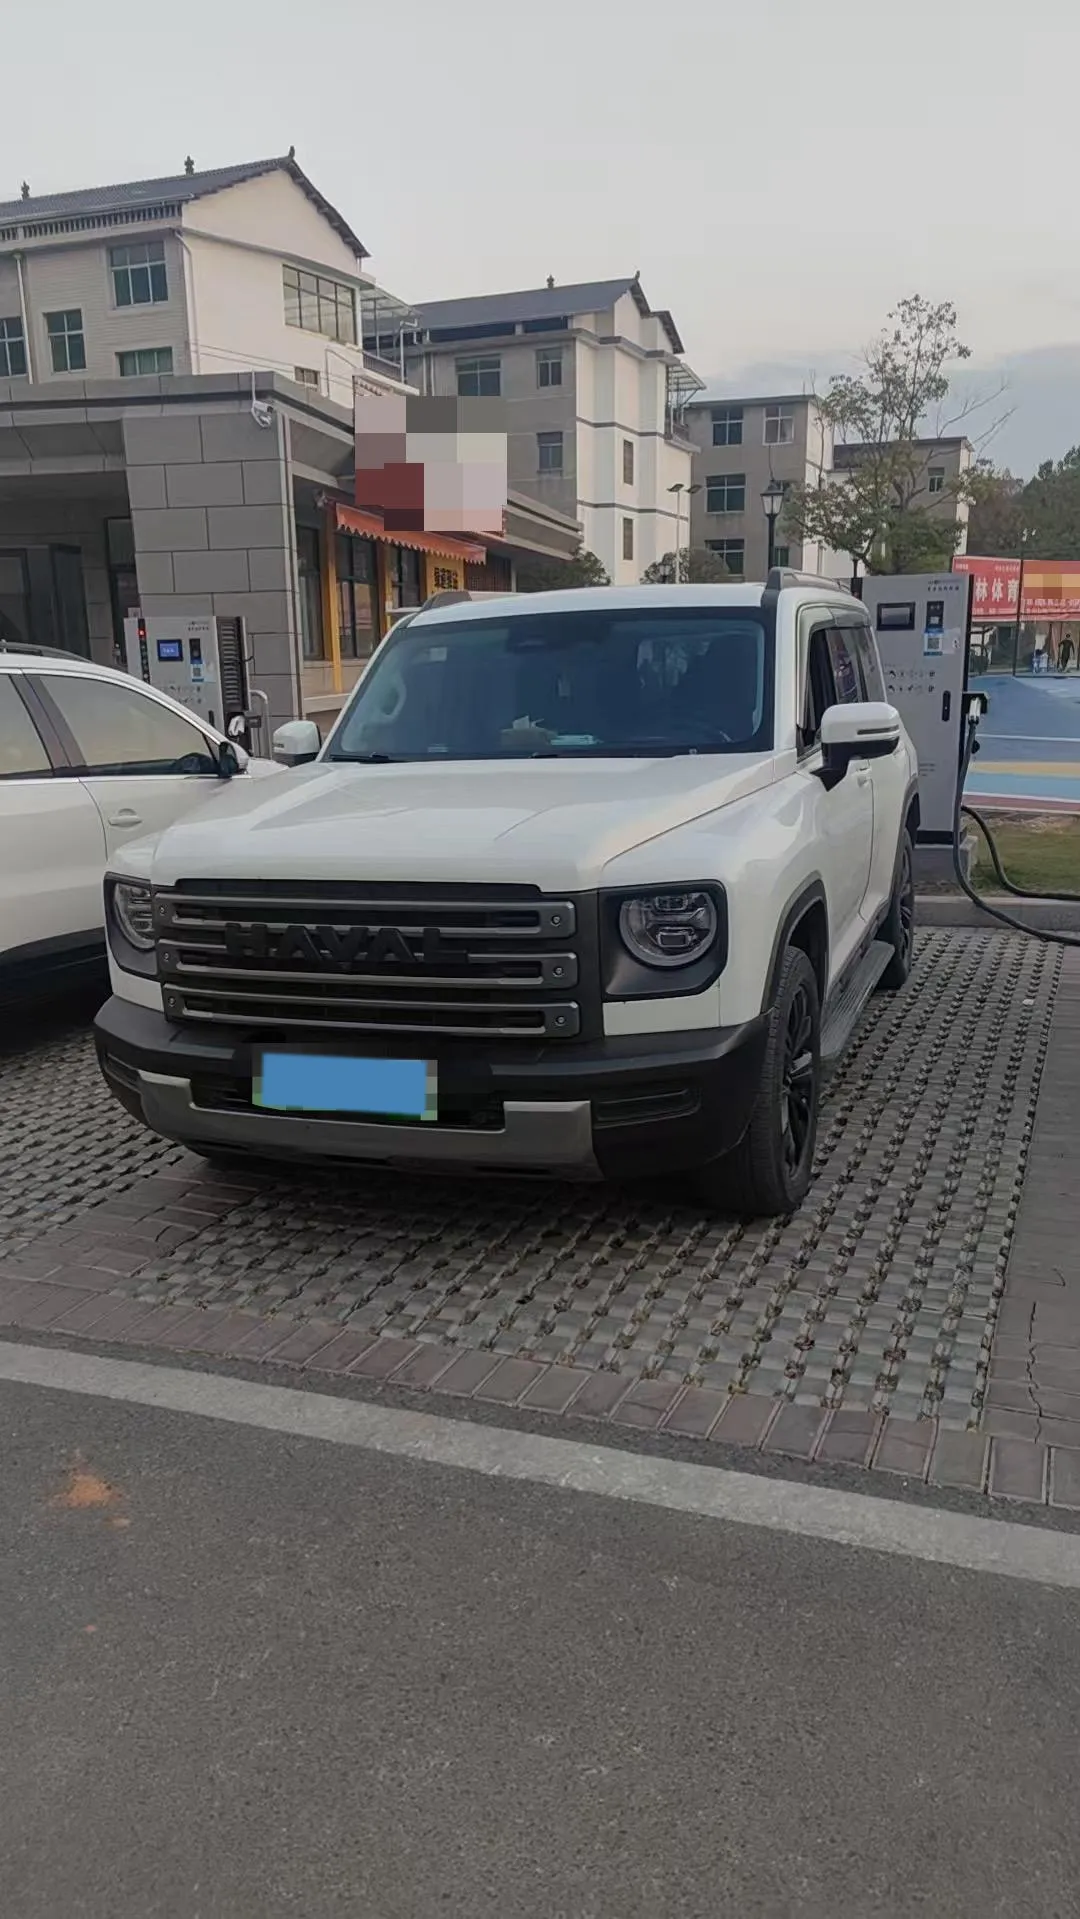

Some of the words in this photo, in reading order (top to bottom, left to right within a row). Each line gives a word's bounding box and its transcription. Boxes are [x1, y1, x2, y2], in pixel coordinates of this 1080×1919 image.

[975, 577, 1020, 602] 林体育
[225, 922, 468, 965] HAVAL
